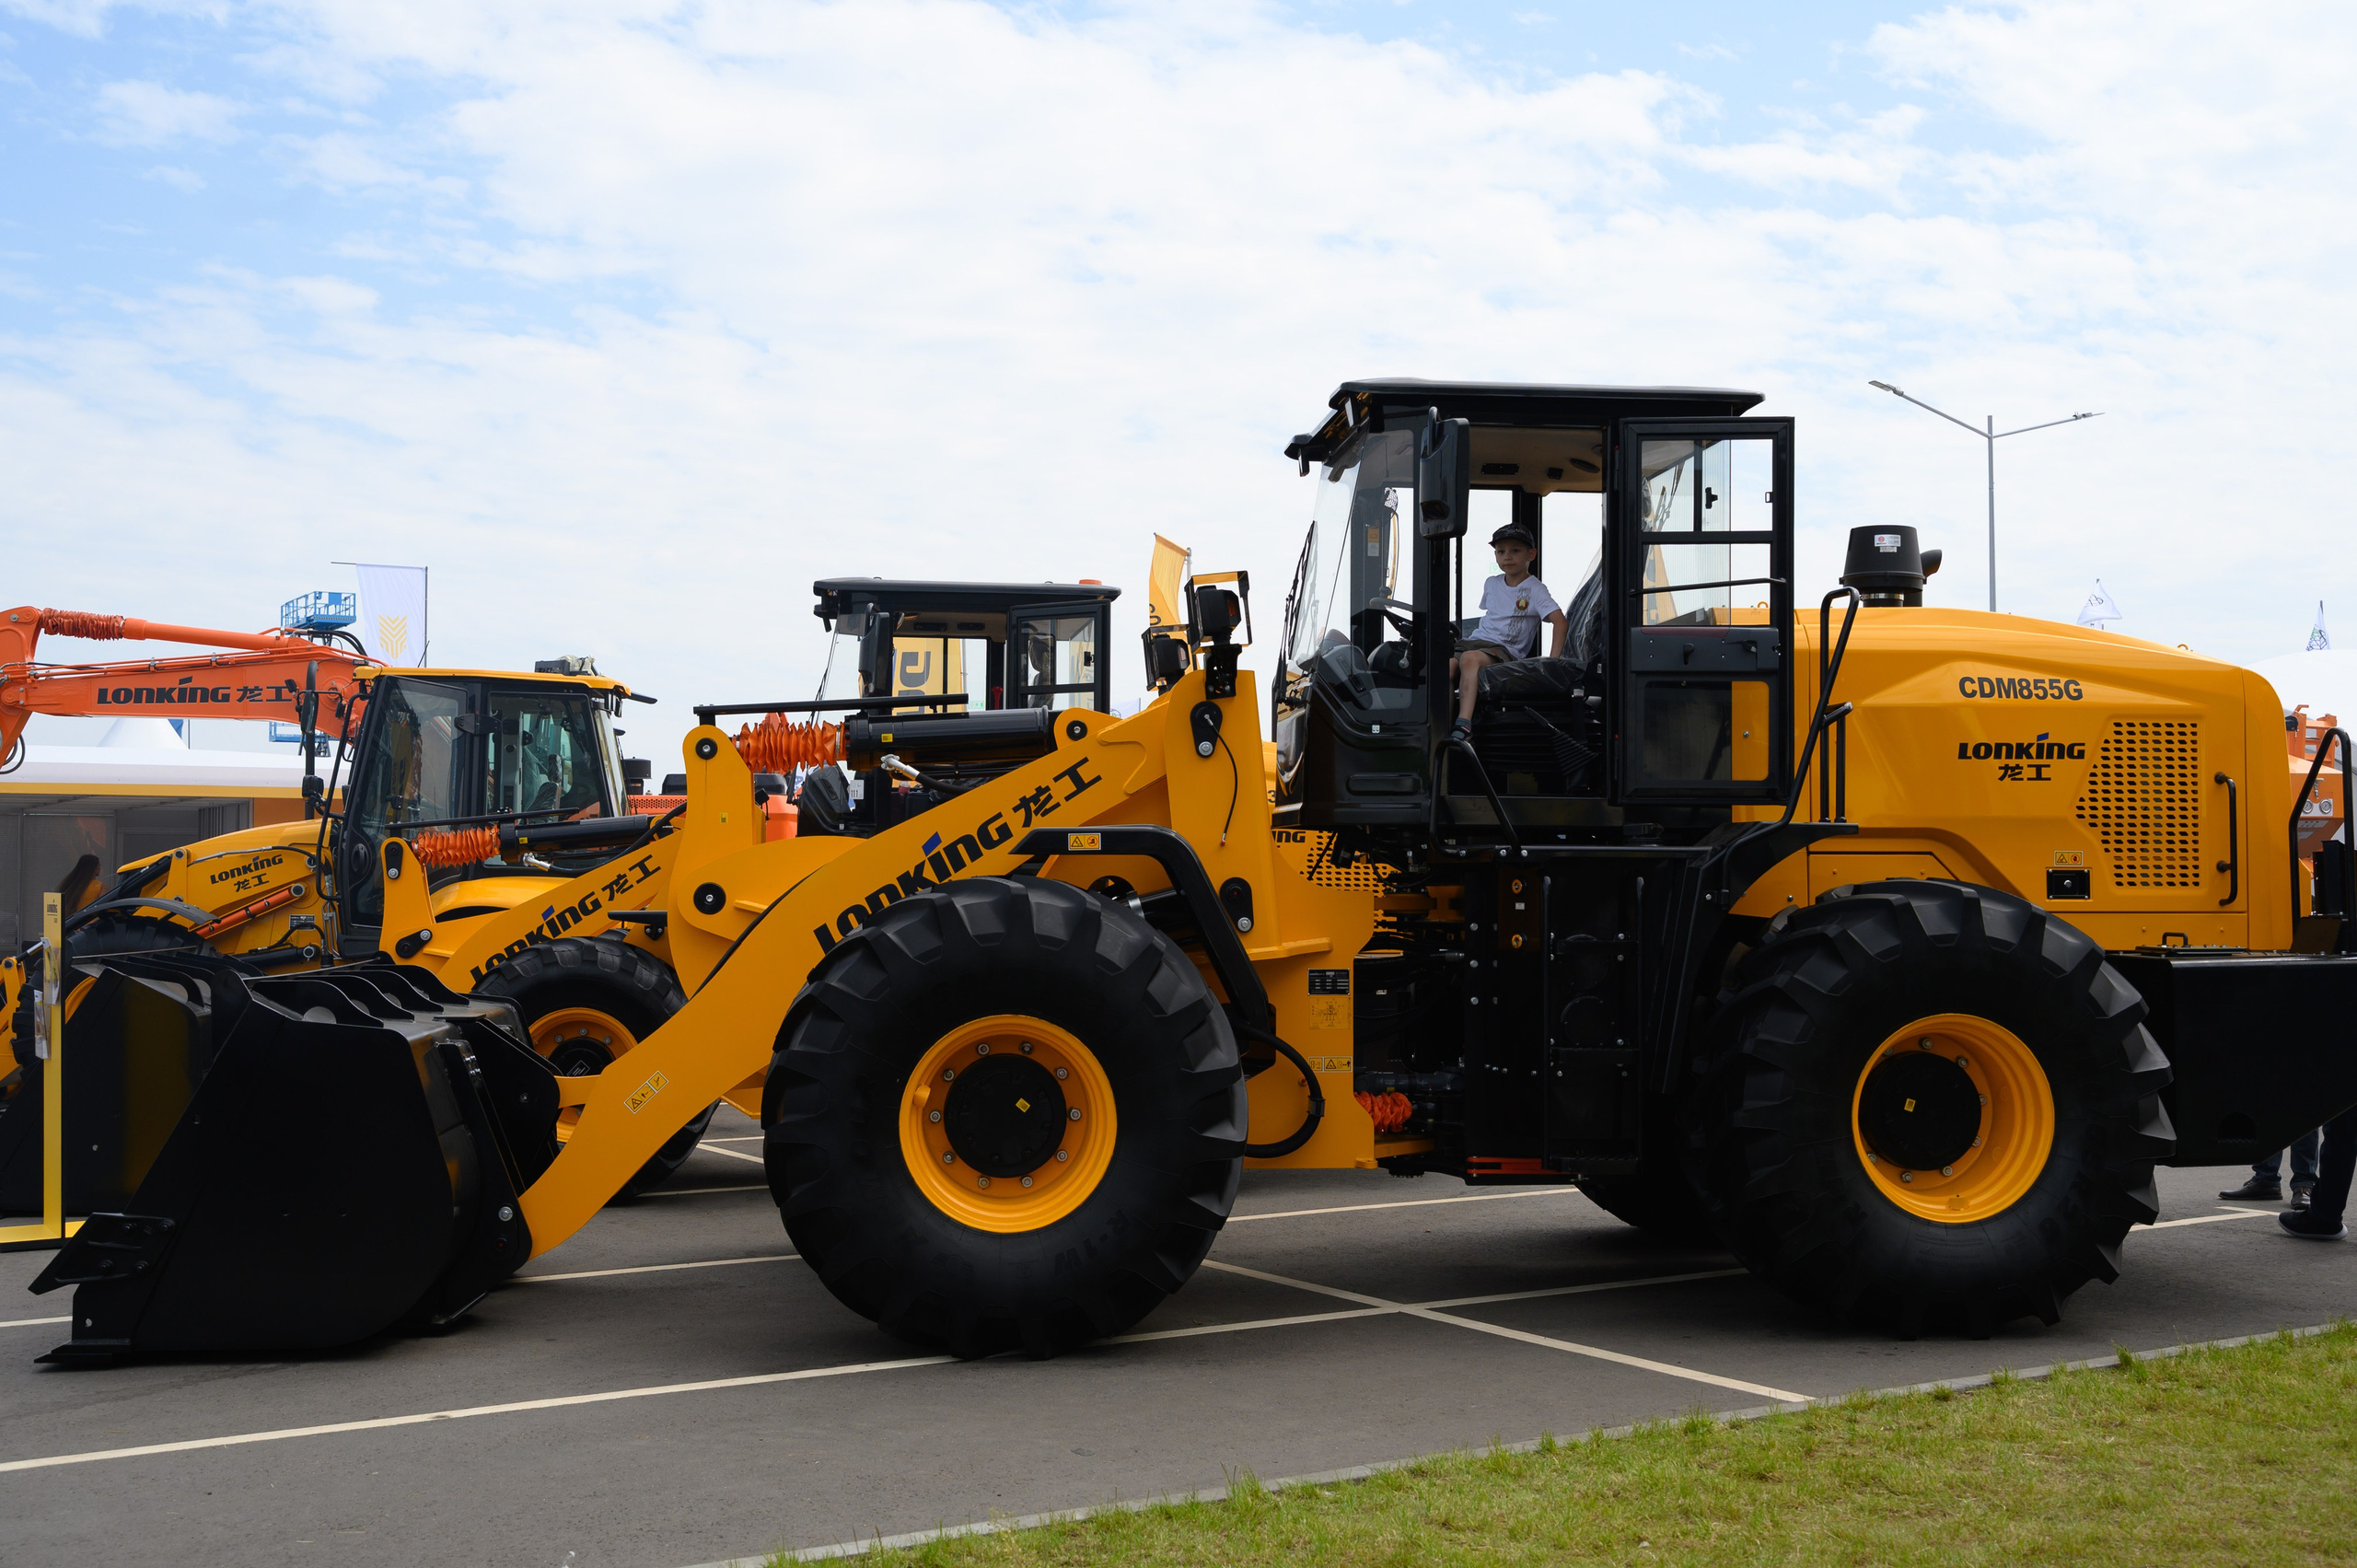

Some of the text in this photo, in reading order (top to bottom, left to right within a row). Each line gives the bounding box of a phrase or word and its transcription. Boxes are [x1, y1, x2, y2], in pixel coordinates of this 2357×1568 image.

[236, 684, 293, 703] 龙工
[1958, 676, 2084, 701] CDM855G
[1997, 763, 2052, 782] 龙工
[1012, 756, 1103, 828] 龙工
[233, 872, 270, 893] 龙工
[600, 854, 662, 901] 龙工
